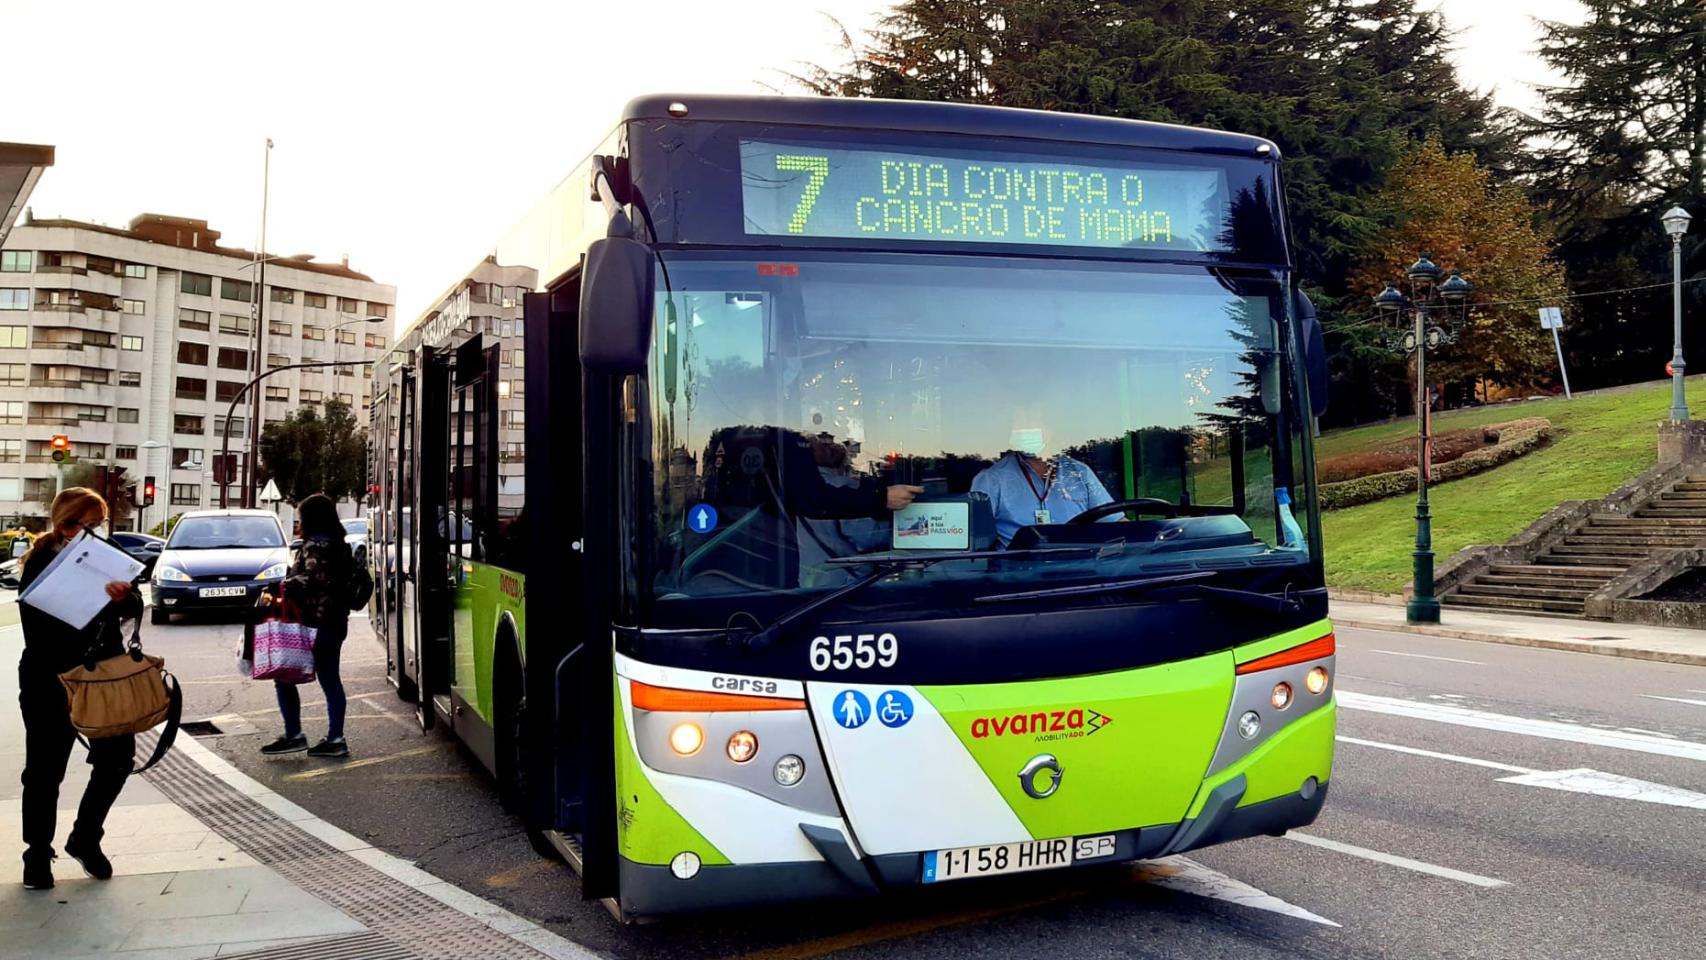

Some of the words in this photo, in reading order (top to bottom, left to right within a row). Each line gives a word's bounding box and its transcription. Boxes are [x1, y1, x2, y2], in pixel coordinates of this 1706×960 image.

[775, 154, 829, 235] 7
[881, 160, 949, 198] DIA
[963, 165, 1108, 205] CONTRA
[1121, 174, 1143, 206] O
[856, 197, 1009, 238] CANCRO
[1023, 205, 1066, 240] DE
[1079, 207, 1171, 243] MAMA
[809, 633, 899, 672] 6559
[711, 676, 778, 694] carsa
[970, 708, 1085, 739] avanza
[1018, 839, 1067, 868] HHR
